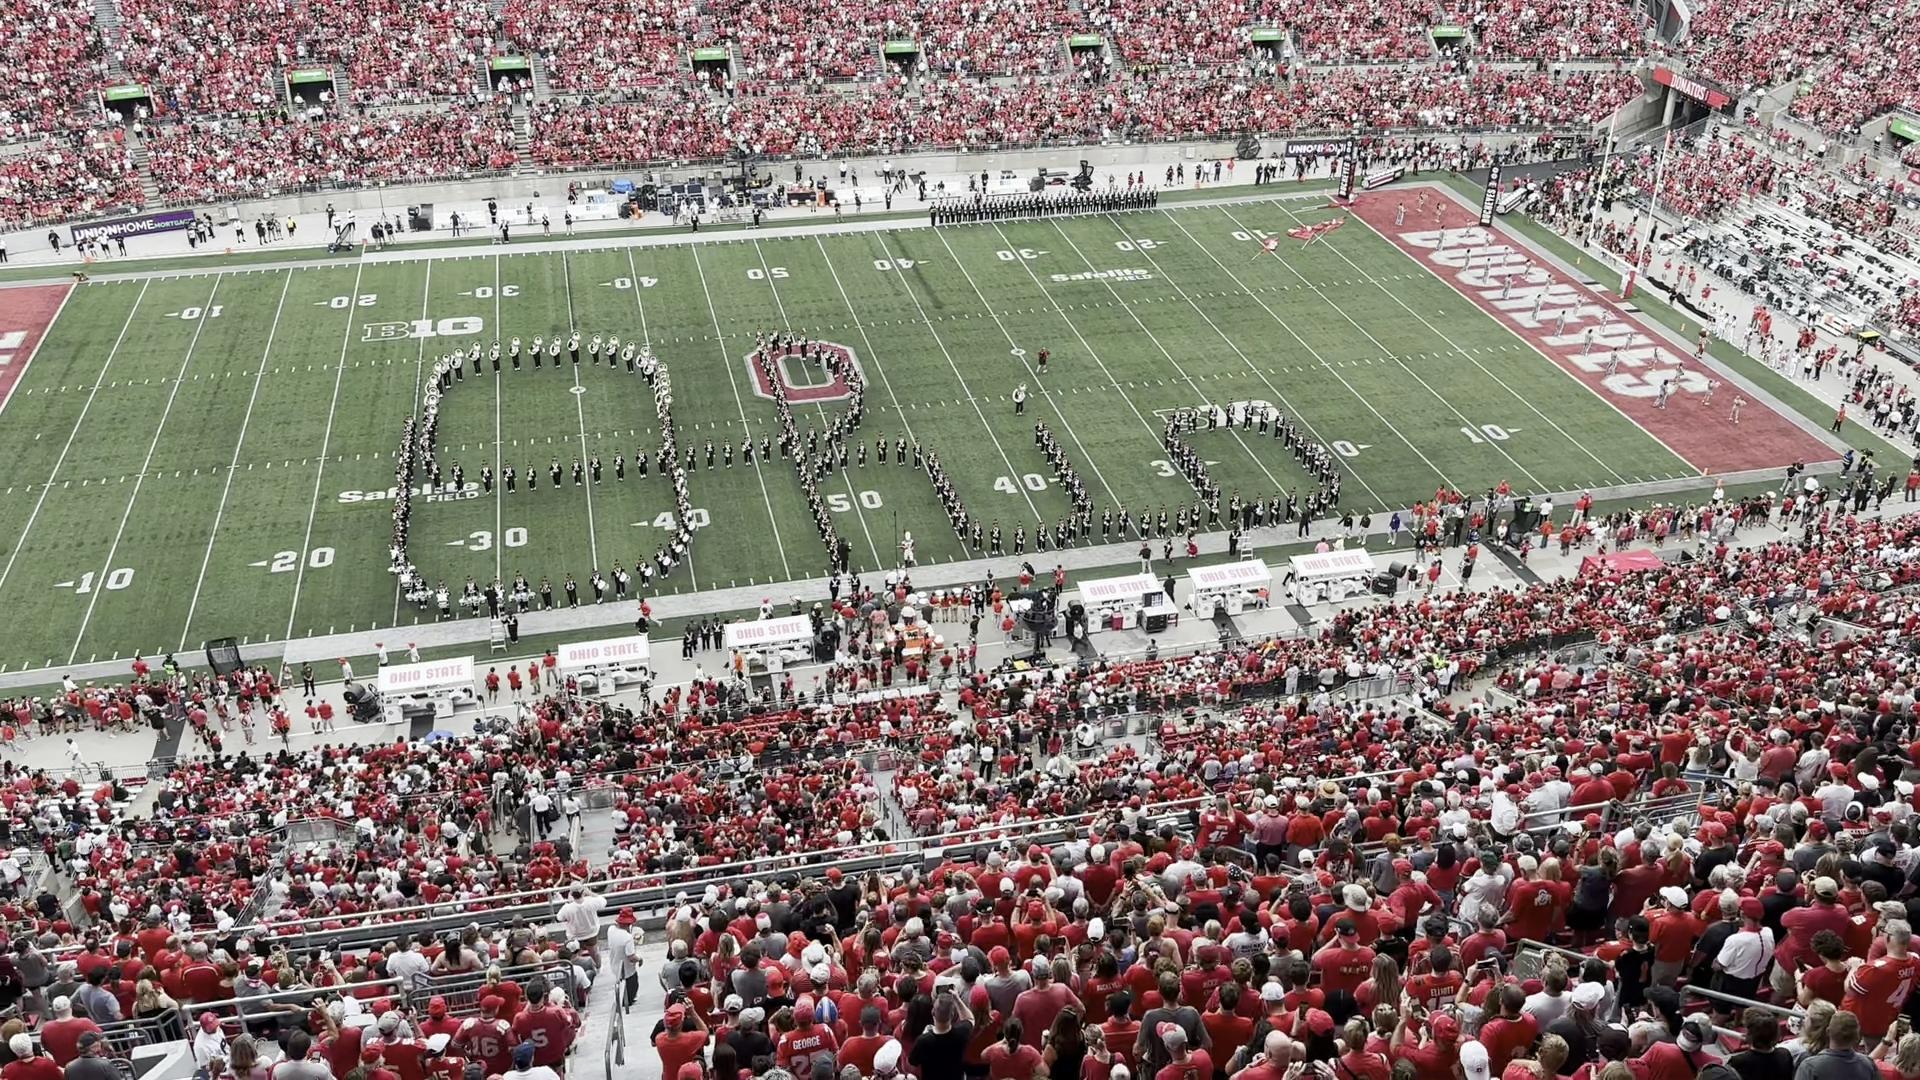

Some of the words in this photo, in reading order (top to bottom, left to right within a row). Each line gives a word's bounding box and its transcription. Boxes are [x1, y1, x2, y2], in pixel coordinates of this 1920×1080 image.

[1670, 74, 1707, 100] DONATOS
[1115, 239, 1157, 251] 20
[873, 257, 915, 271] 40
[996, 249, 1038, 261] 30
[746, 267, 789, 280] 50
[1050, 269, 1150, 282] Safelite
[475, 285, 519, 299] 30
[614, 277, 658, 289] 40
[330, 294, 377, 309] 20
[181, 306, 223, 320] 10
[1397, 227, 1717, 398] BUCKEYES
[1460, 424, 1510, 443] 10
[993, 473, 1048, 495] 40
[426, 491, 479, 503] FIELD
[827, 490, 883, 512] 50
[653, 508, 710, 531] 40
[469, 527, 527, 550] 30
[270, 547, 335, 573] 20
[75, 568, 135, 593] 10
[1089, 584, 1116, 596] OHIO
[1119, 580, 1150, 592] STATE
[736, 627, 764, 640] OHIO
[768, 622, 802, 636] STATE
[569, 647, 599, 661] OHIO
[603, 642, 639, 657] STATE
[389, 670, 420, 684] OHIO
[426, 664, 463, 679] STATE
[1431, 985, 1454, 997] ELLIOTT
[1886, 979, 1912, 1008] 4
[471, 1036, 499, 1057] 16
[531, 1028, 549, 1047] 5
[793, 1035, 821, 1051] GEORGE
